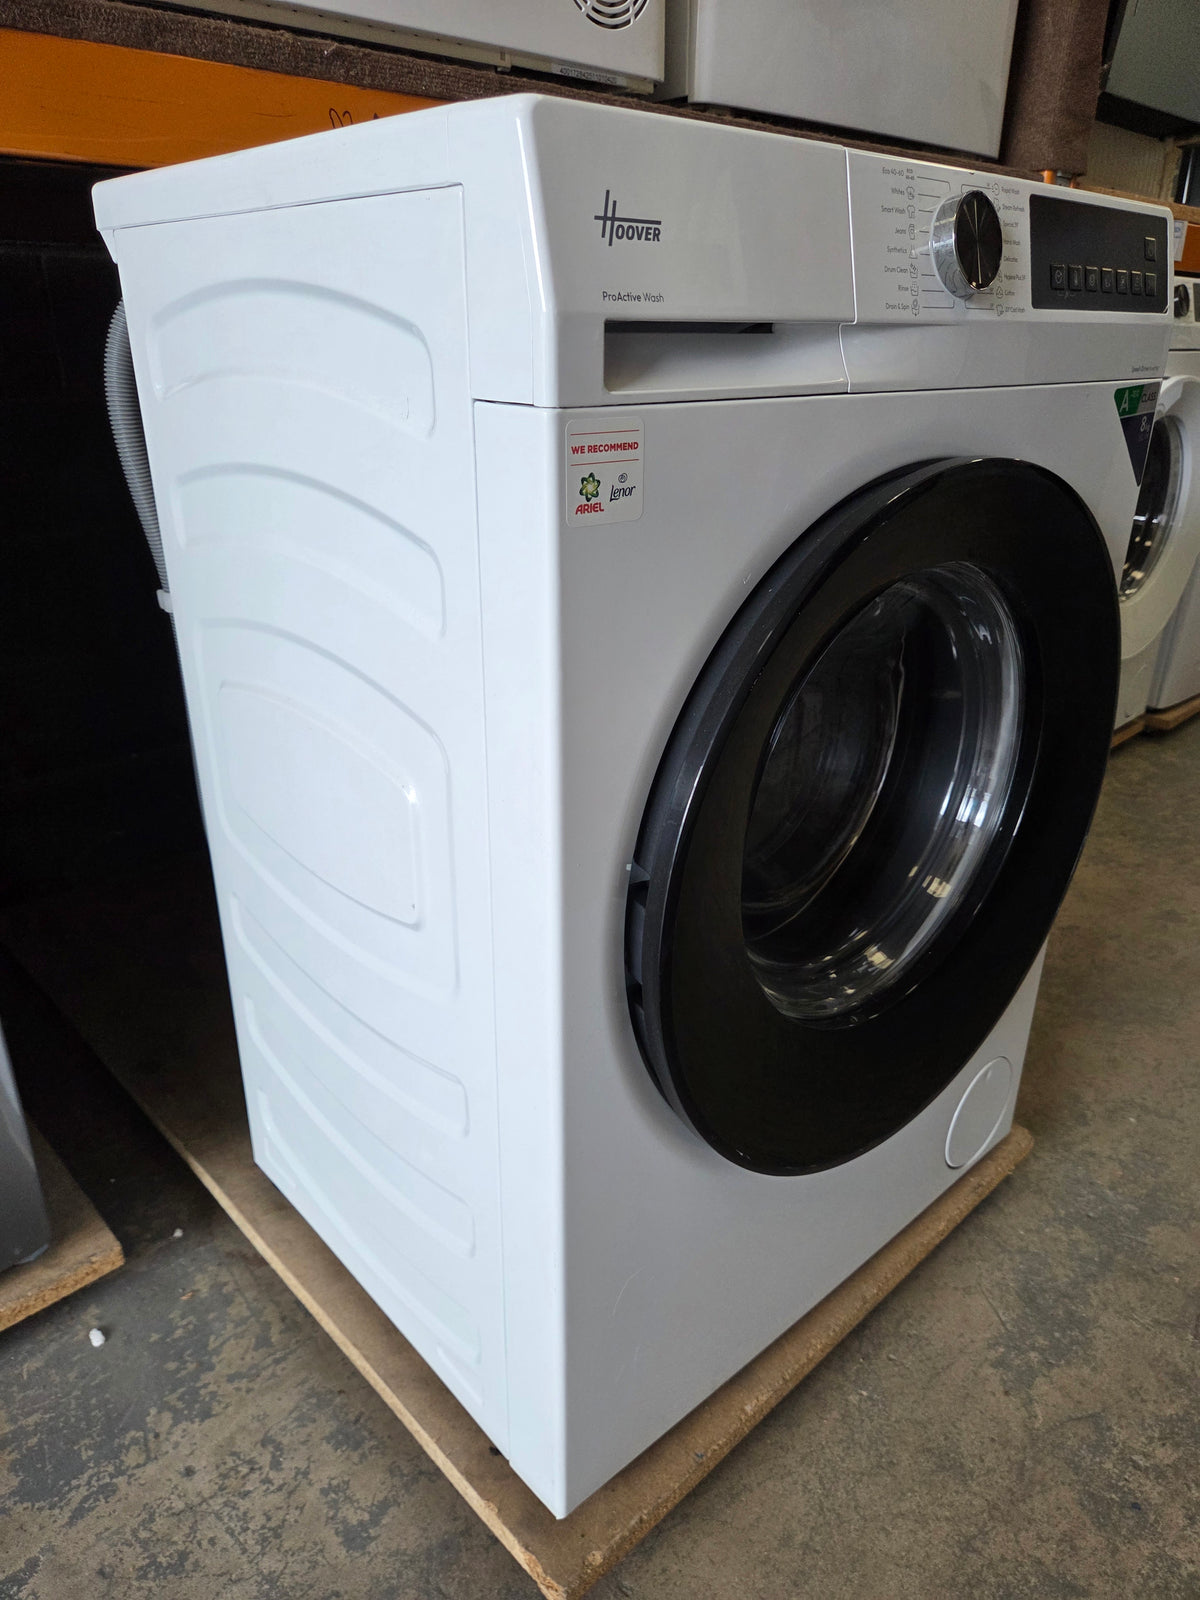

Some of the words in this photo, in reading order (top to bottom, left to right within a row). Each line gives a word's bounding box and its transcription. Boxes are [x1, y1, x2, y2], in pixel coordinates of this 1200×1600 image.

[594, 189, 662, 246] HOOVER
[602, 290, 642, 302] ProActive
[642, 291, 665, 303] Wash
[1119, 389, 1130, 414] A
[1141, 390, 1157, 403] CLASS
[571, 445, 586, 455] WE
[587, 441, 639, 454] RECOMMEND
[609, 484, 636, 502] Lenor
[575, 502, 605, 516] ARIEL
